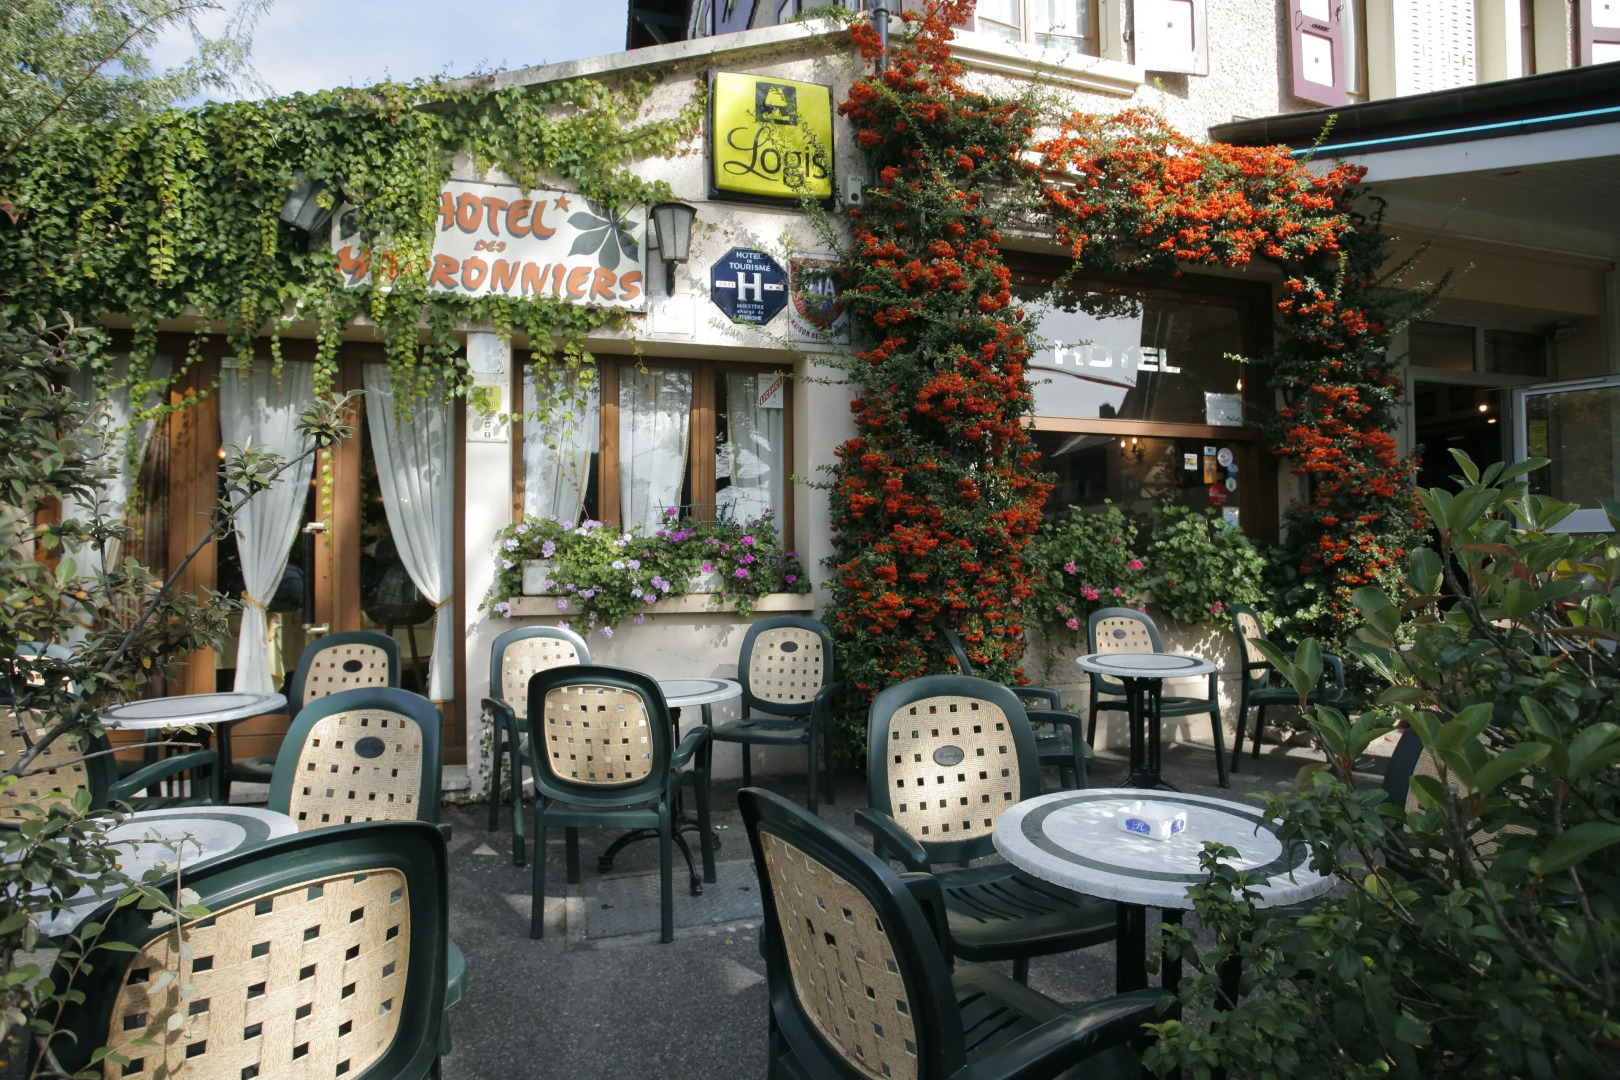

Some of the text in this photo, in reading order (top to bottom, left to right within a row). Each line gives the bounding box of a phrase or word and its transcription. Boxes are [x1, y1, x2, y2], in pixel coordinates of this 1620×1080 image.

[723, 126, 828, 188] Logis
[439, 192, 557, 240] HOTEL
[473, 239, 507, 253] DES
[729, 262, 771, 272] TOURISME
[737, 272, 763, 302] H
[790, 319, 810, 338] MAISON
